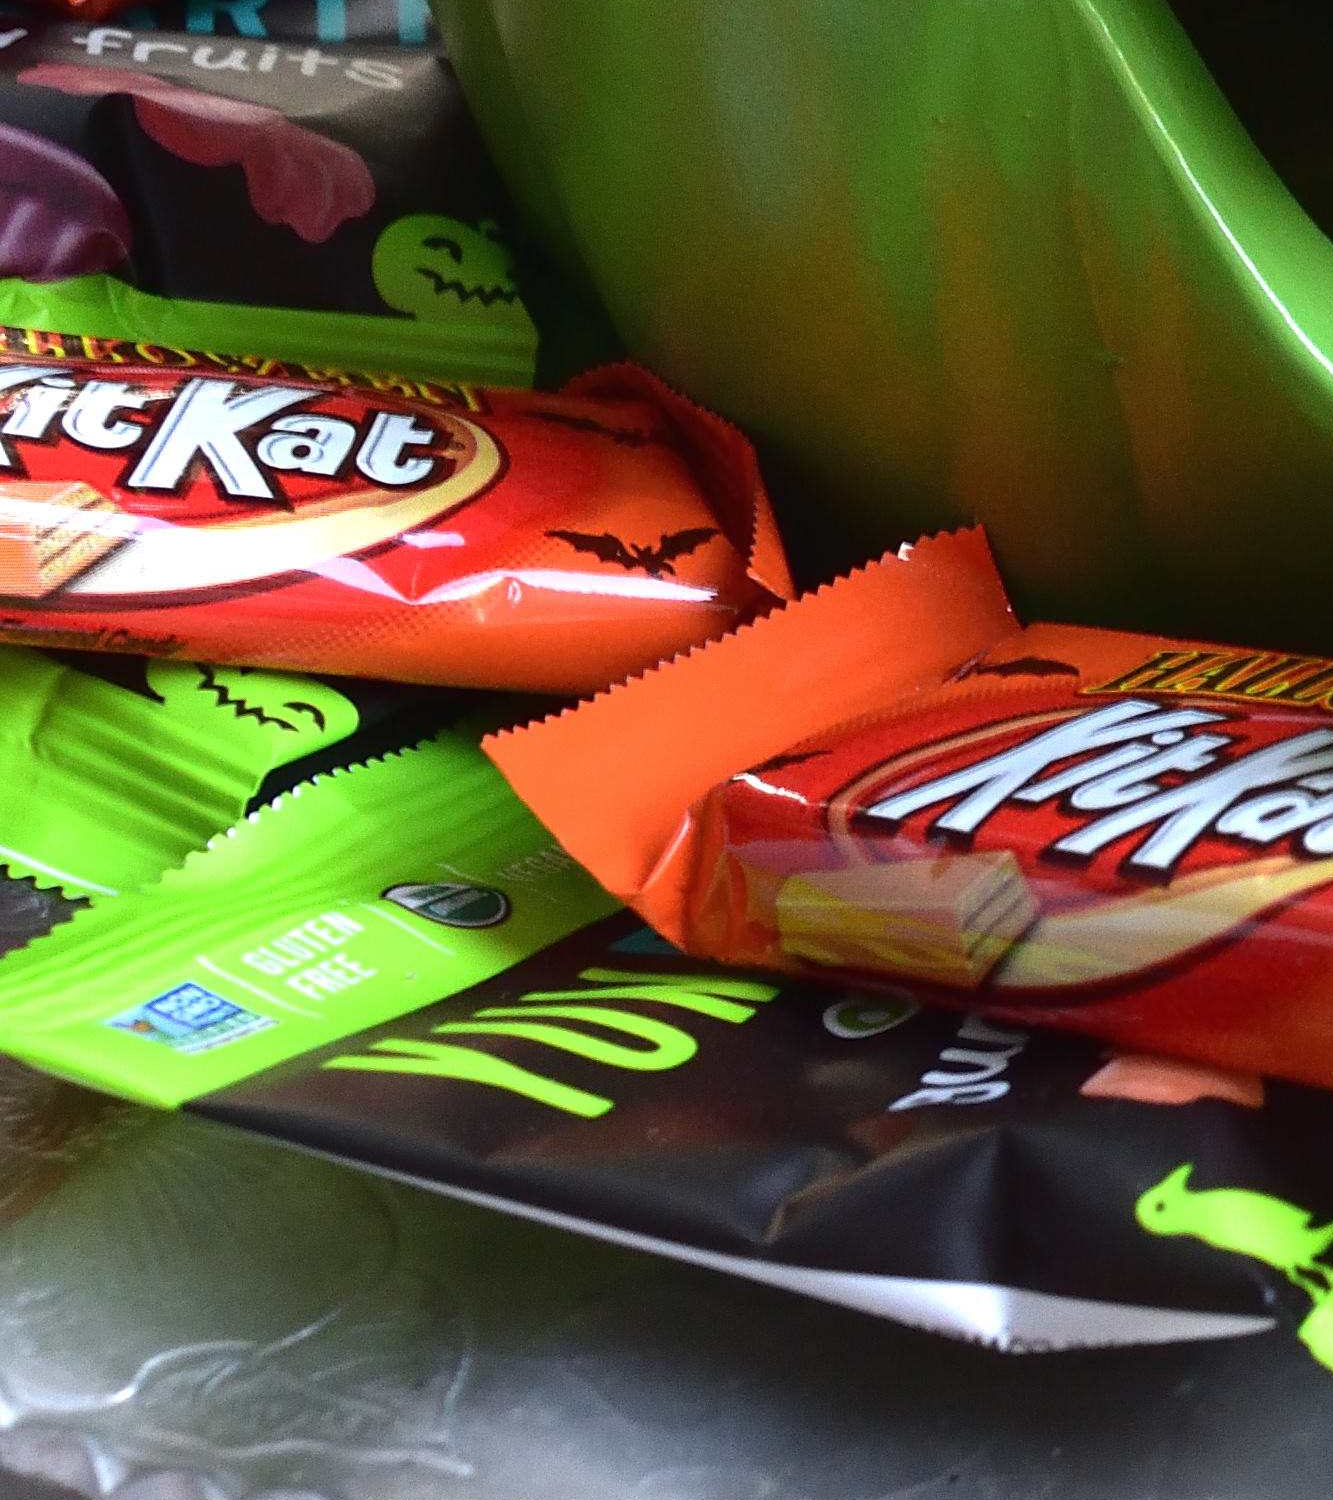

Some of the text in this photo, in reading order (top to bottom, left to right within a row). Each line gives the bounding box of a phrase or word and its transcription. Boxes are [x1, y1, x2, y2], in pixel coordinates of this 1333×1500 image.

[72, 26, 402, 90] fruits
[241, 910, 366, 977] GLUTEN
[284, 952, 379, 1000] FREE
